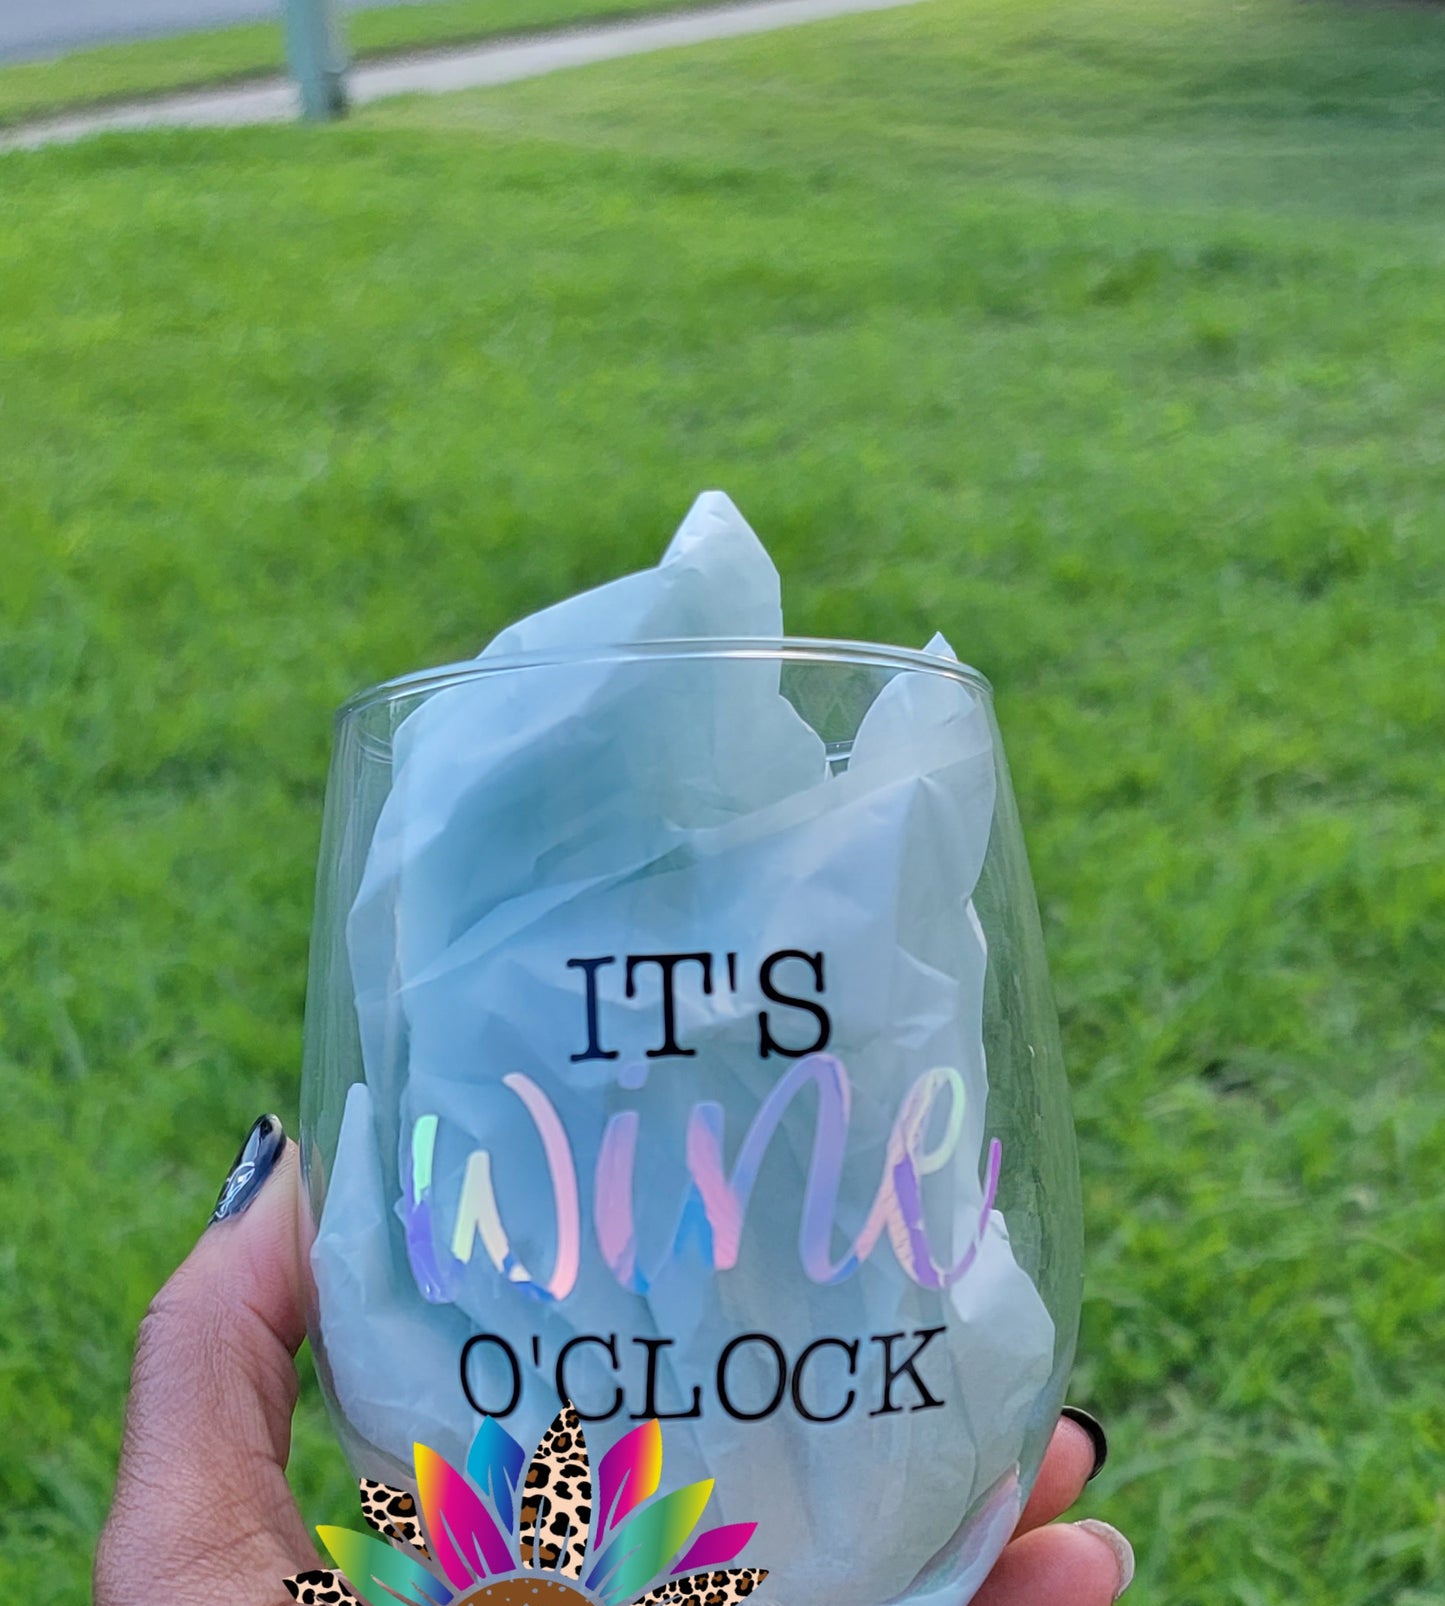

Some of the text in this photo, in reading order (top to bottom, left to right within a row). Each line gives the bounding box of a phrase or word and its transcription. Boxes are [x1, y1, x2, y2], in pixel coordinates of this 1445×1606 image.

[566, 949, 832, 1063] IT'S
[405, 1051, 1002, 1303] wine
[459, 1326, 947, 1422] O'CLOCK
